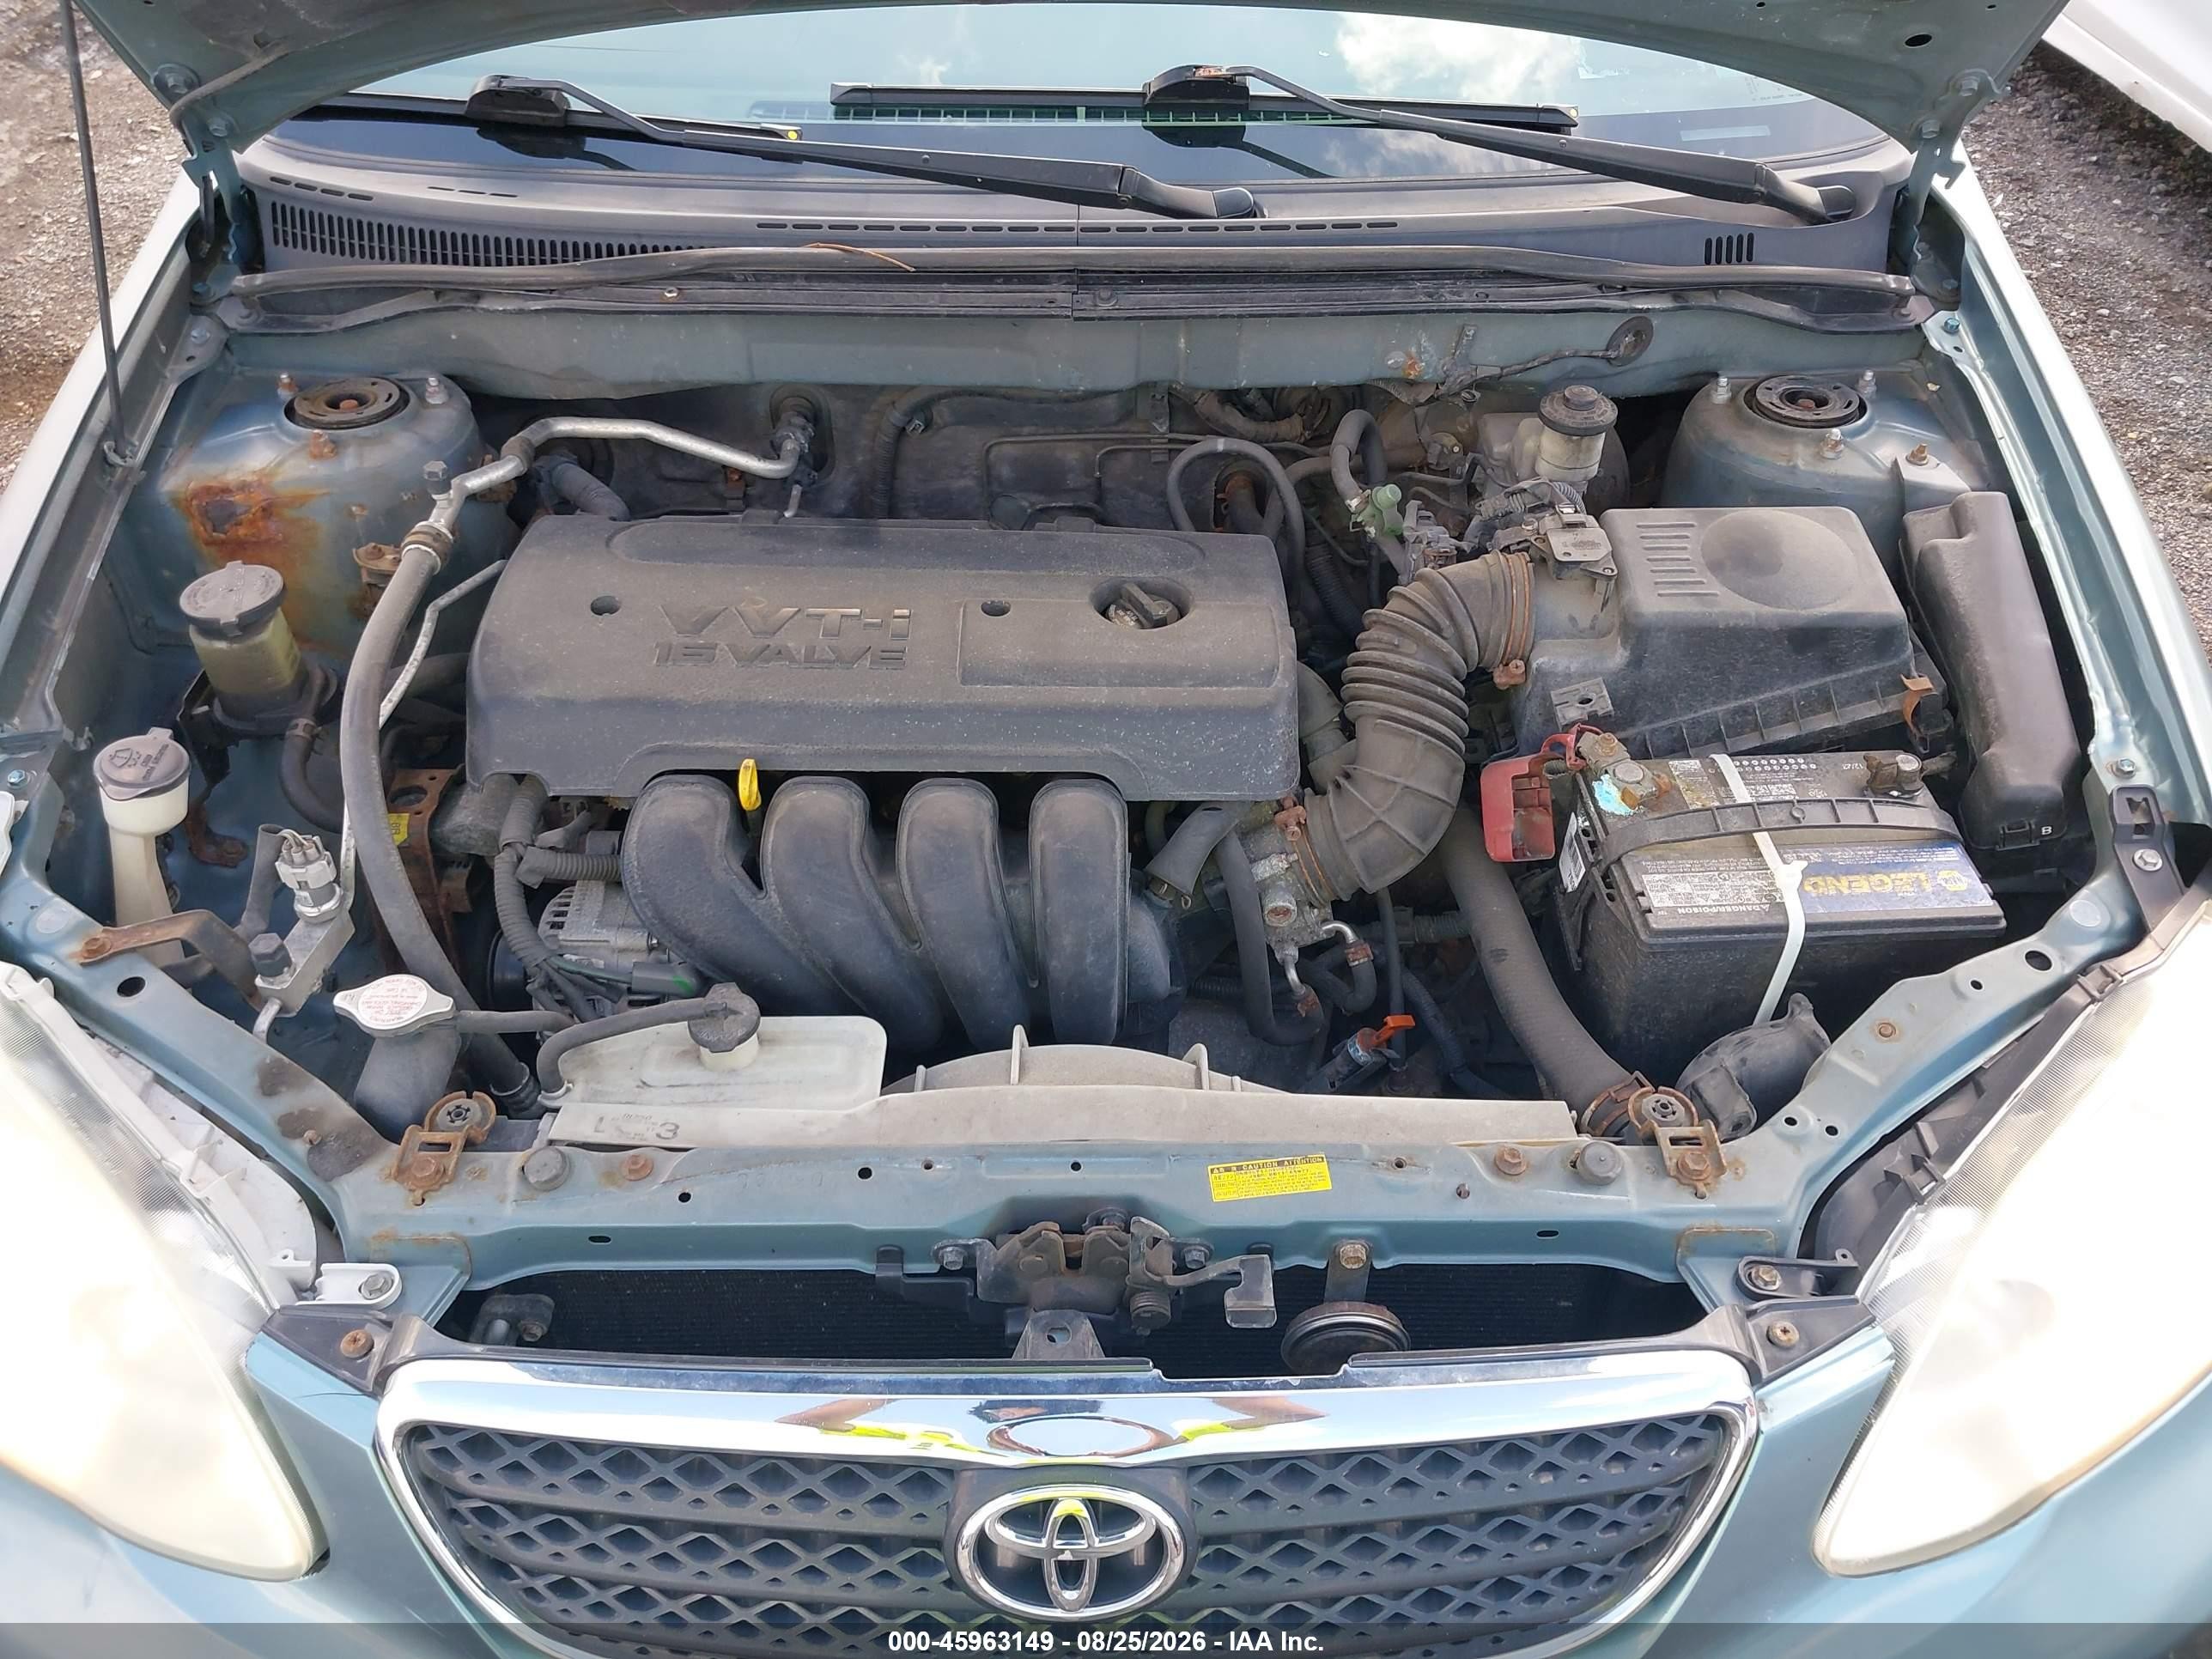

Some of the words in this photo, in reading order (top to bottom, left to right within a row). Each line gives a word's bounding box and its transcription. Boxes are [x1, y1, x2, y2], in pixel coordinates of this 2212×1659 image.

[658, 605, 912, 640] VVT-i
[1804, 872, 1931, 894] LEGEND
[1242, 1162, 1278, 1170] CAUTION
